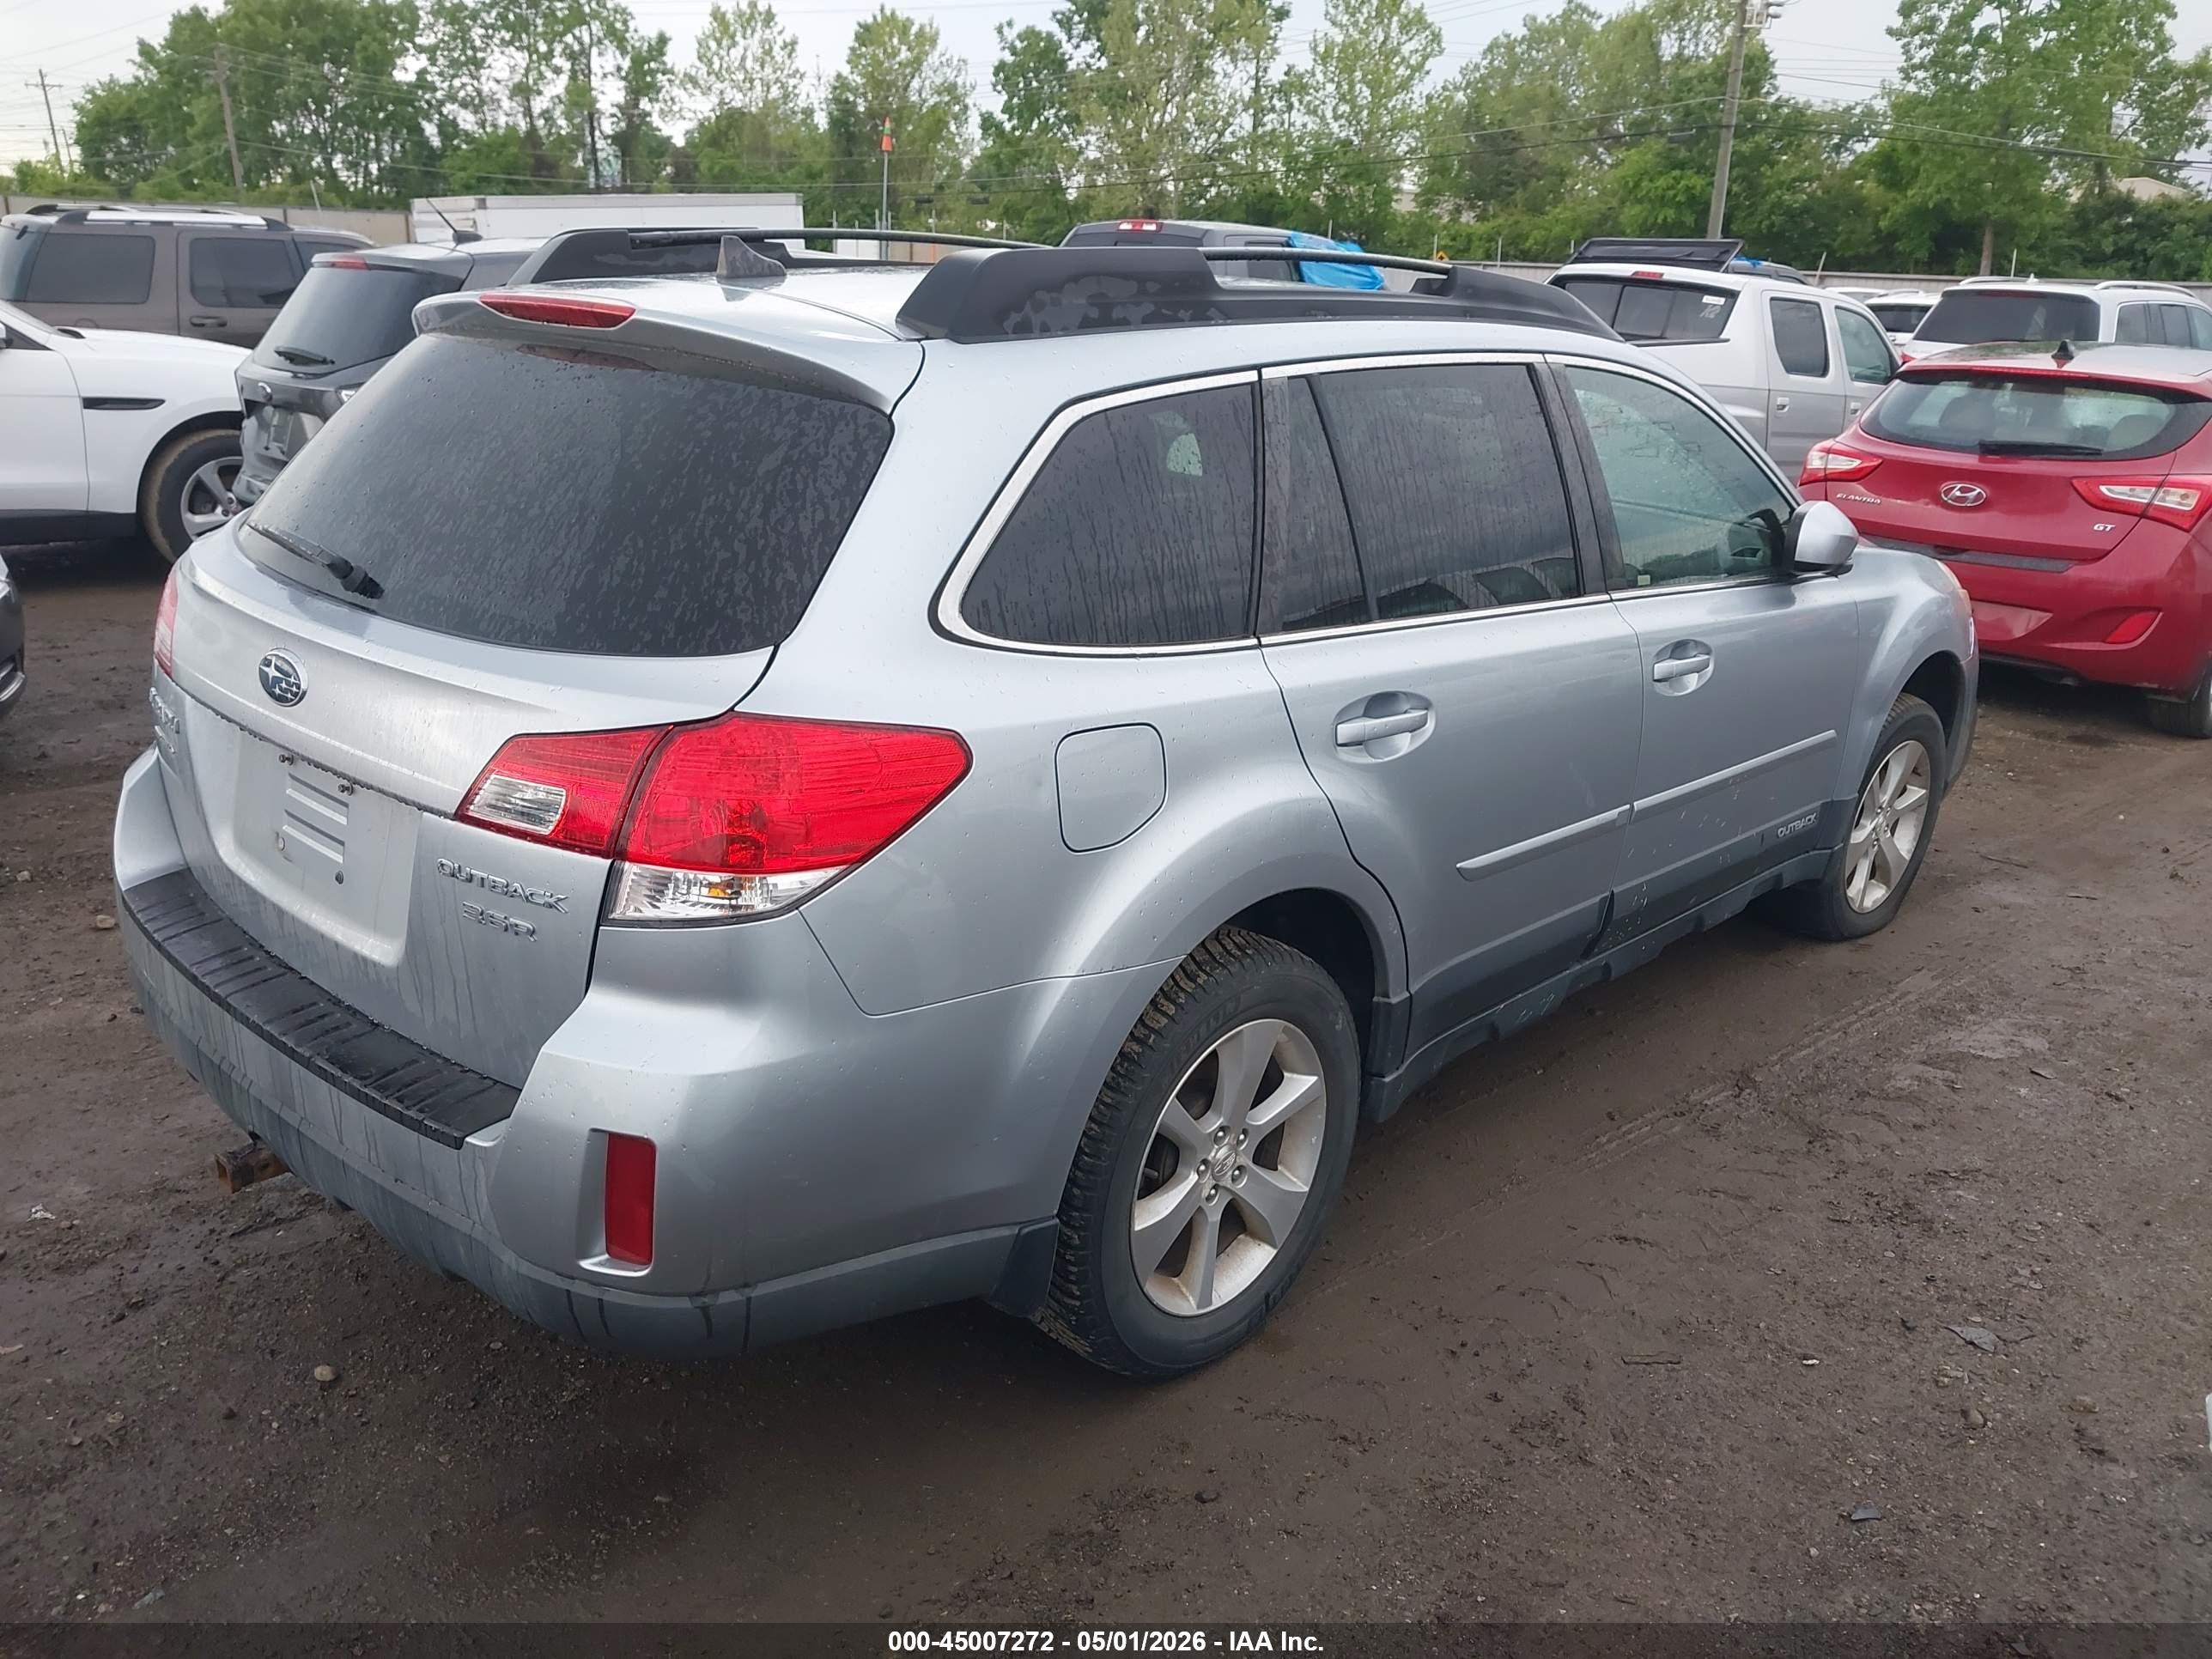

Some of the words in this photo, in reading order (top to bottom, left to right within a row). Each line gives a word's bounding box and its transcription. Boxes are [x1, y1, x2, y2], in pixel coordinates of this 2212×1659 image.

[1836, 493, 1881, 504] ELANTRA
[2094, 523, 2116, 532] GT
[1778, 812, 1817, 838] OUTBACK
[436, 858, 569, 914] OUTBACK
[462, 901, 538, 942] 3.6R
